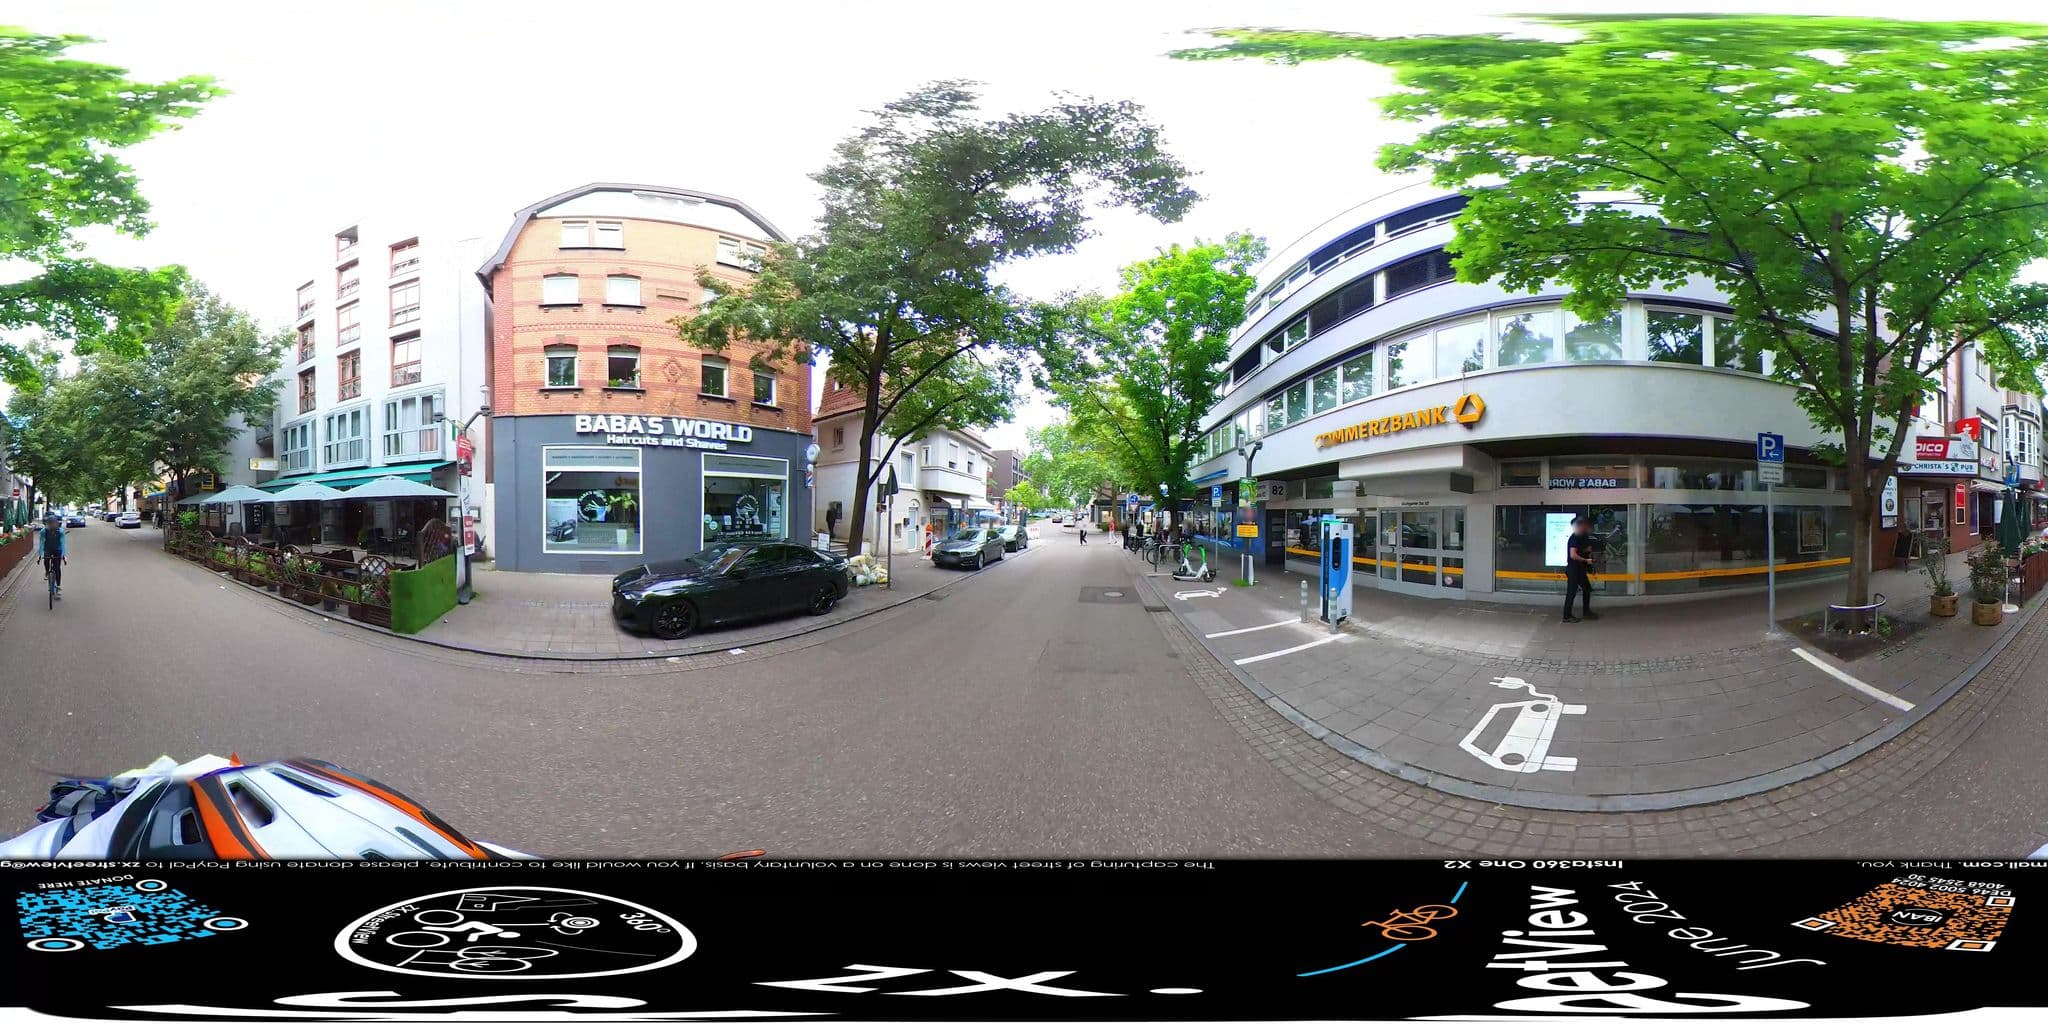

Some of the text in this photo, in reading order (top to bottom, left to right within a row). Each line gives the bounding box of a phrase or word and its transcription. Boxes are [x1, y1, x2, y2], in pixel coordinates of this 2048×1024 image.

[672, 418, 752, 443] WORLD
[1313, 405, 1447, 449] COMMERZBANK
[606, 434, 728, 450] Haircuts and Shaves
[1762, 436, 1776, 458] P
[1272, 485, 1284, 496] 82
